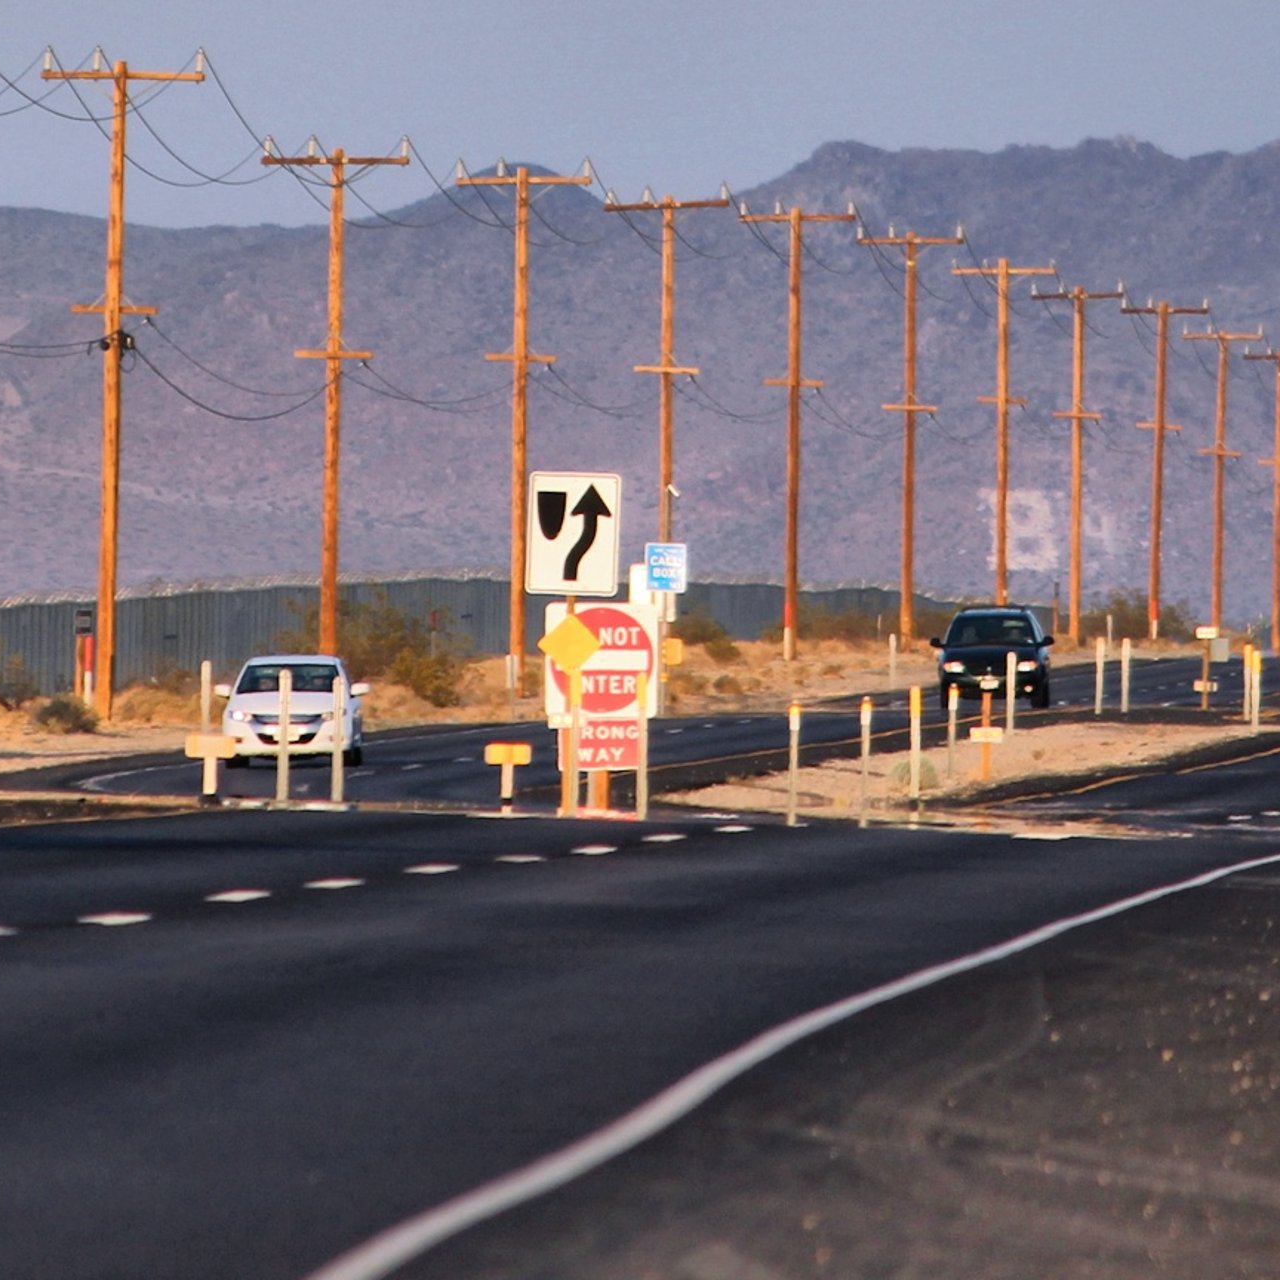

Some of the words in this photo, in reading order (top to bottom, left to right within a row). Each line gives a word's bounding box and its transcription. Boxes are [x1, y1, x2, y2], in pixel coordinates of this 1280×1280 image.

[599, 626, 641, 646] NOT
[581, 675, 636, 694] NTER
[581, 725, 641, 740] RONG
[577, 747, 625, 763] WAY
